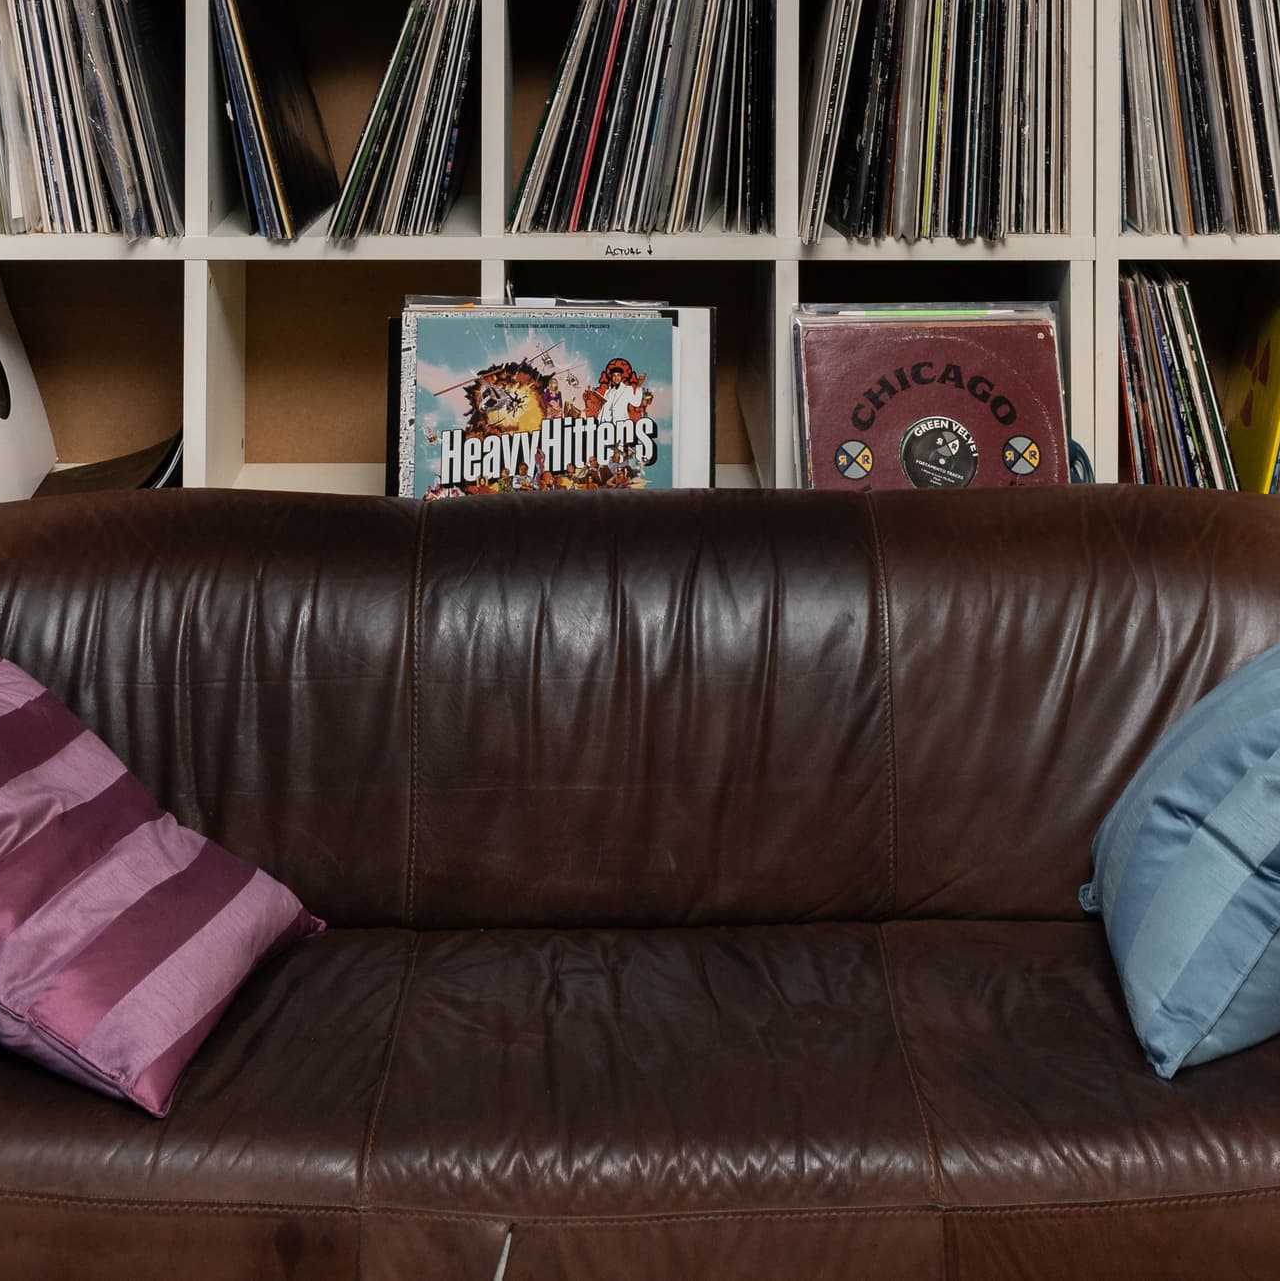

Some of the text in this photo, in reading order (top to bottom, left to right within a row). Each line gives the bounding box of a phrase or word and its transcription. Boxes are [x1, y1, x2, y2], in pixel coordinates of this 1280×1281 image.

[605, 245, 641, 256] ACTUAL
[851, 361, 1018, 432] CHICAGO
[914, 420, 949, 437] GREEN
[951, 423, 979, 457] VELVET
